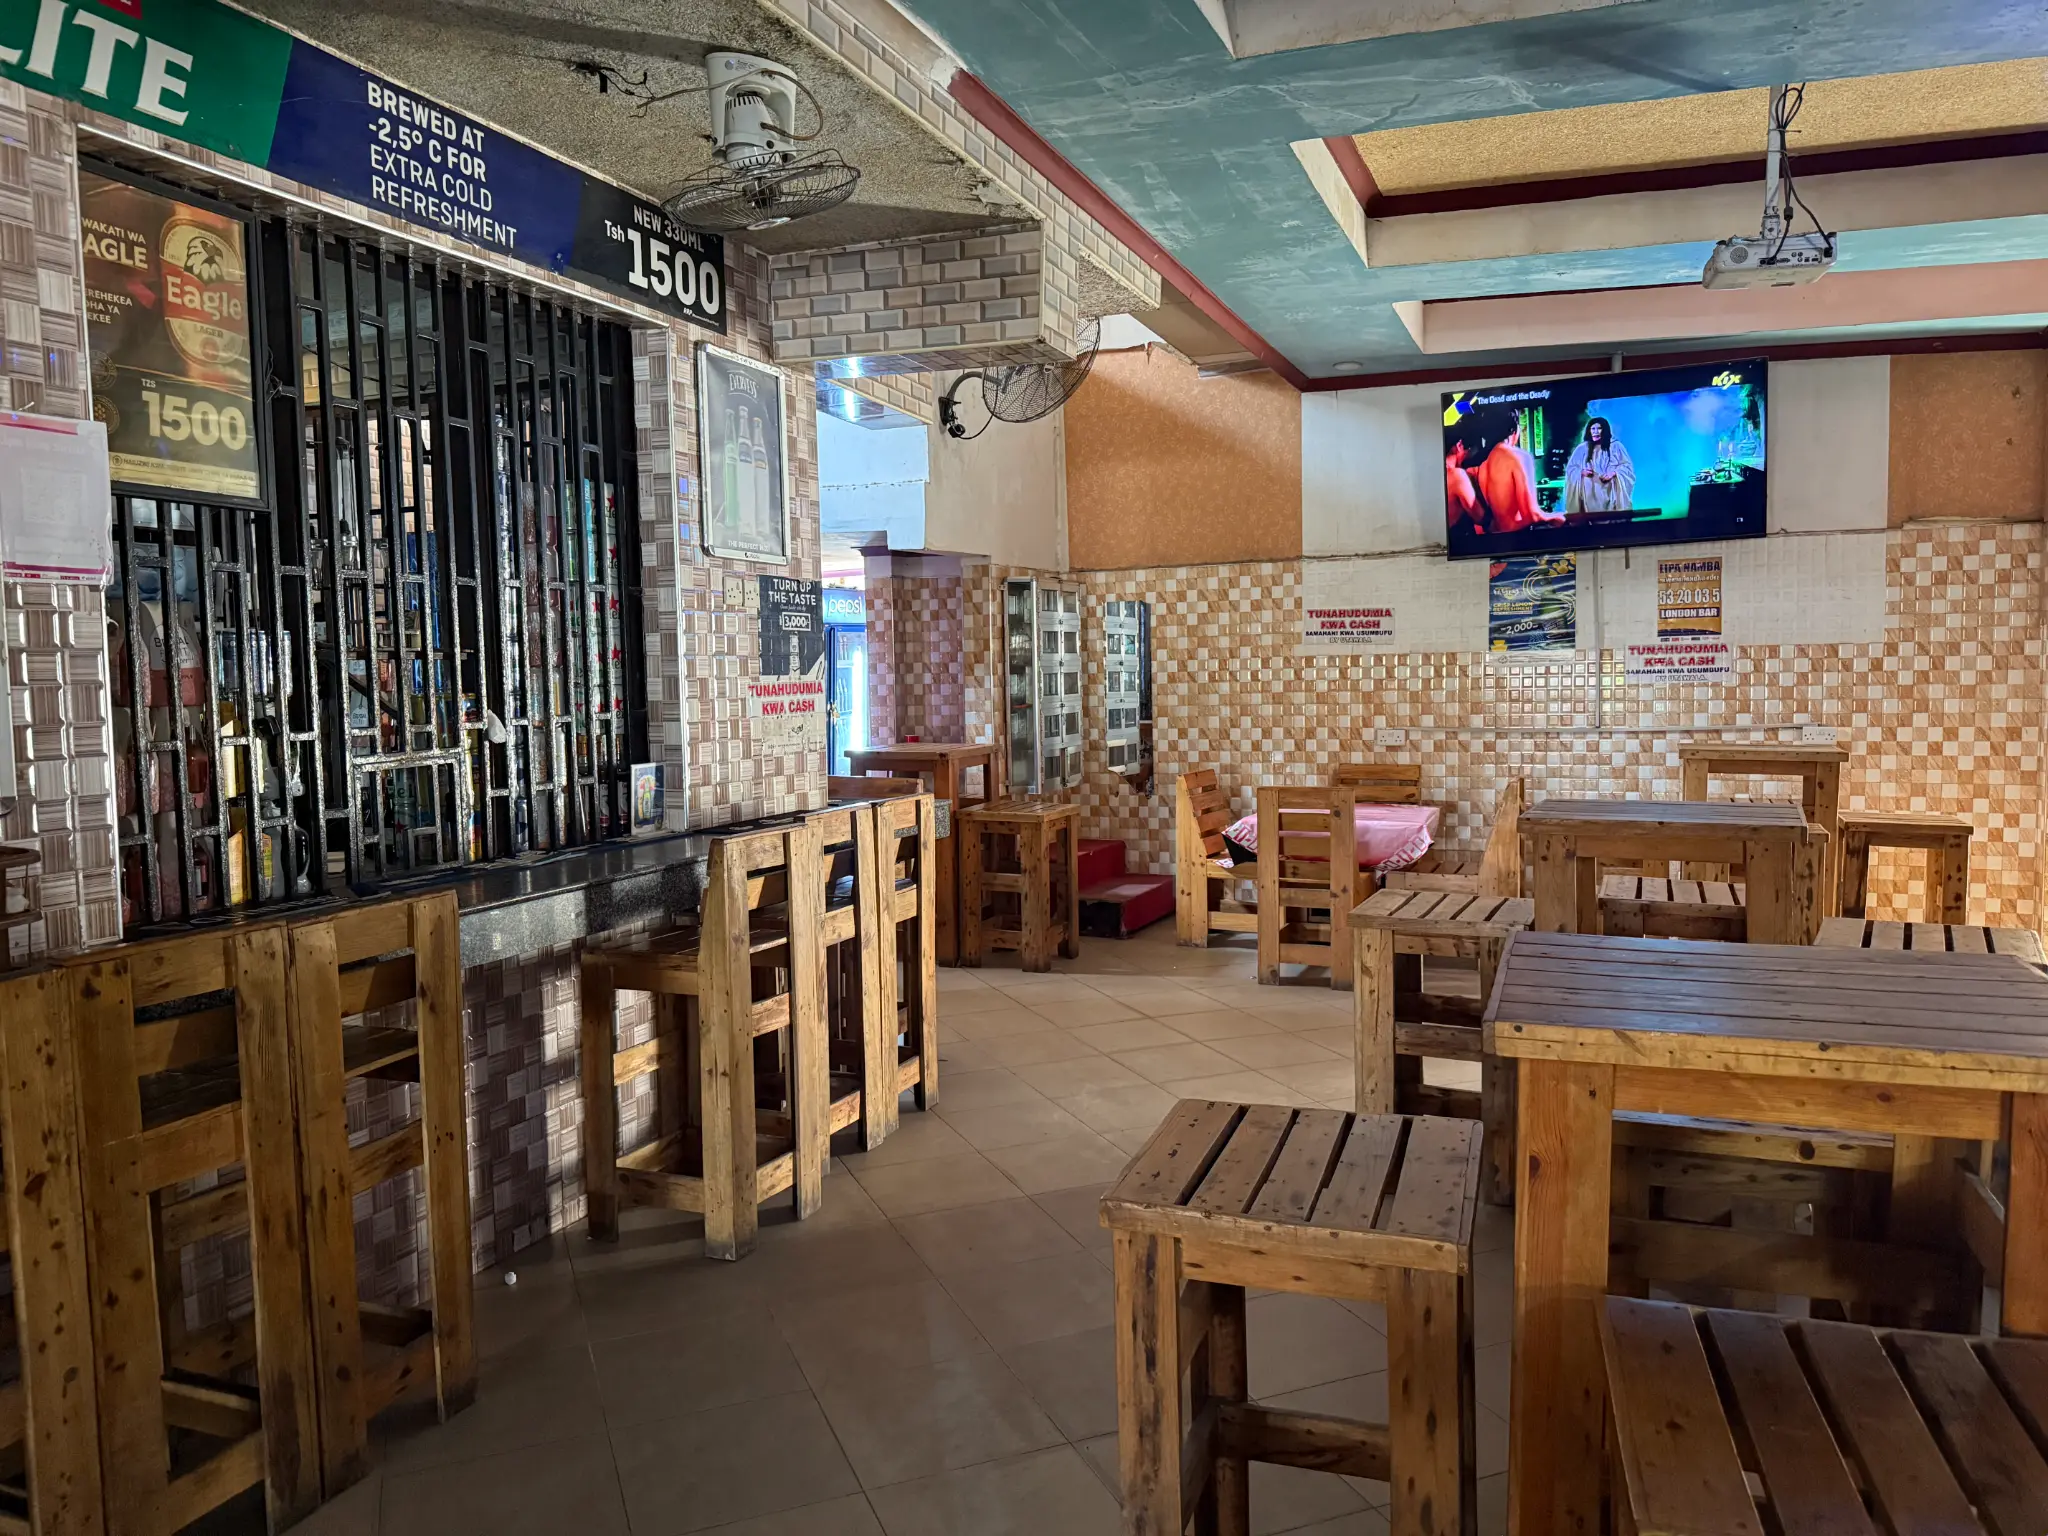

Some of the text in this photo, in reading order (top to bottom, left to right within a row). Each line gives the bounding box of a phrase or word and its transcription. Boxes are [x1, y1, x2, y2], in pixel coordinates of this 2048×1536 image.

[368, 81, 485, 152] BREWED AT
[428, 139, 442, 164] C
[447, 146, 486, 182] FOR
[370, 144, 492, 212] EXTRA COLD
[372, 175, 517, 249] REFRESHMENT
[81, 217, 147, 244] WAKATI WA
[633, 205, 705, 253] NEW 330ML
[604, 219, 720, 315] Tsh 1500
[166, 275, 242, 321] Eagle
[107, 304, 120, 316] YA
[141, 378, 156, 389] TZS
[1478, 396, 1488, 404] The
[1490, 395, 1504, 403] Dead
[1519, 392, 1528, 400] the
[1530, 390, 1551, 399] Deadly
[141, 390, 246, 451] 1500
[1660, 561, 1720, 574] LIPA NAMBA
[773, 579, 812, 593] TURN UP
[768, 591, 816, 606] THE TASTE
[1659, 588, 1720, 605] 53 20 03 5
[828, 596, 862, 617] pepsi
[1307, 608, 1392, 618] TUNAHUDUMIA
[1661, 608, 1718, 618] LONDON BAR
[1320, 620, 1381, 629] KWA CASH
[1628, 643, 1729, 655] TUNAHUDUMIA
[1644, 656, 1716, 667] KWA CASH
[748, 682, 824, 697] TUNAHUDUMIA
[762, 700, 815, 715] KWA CASH
